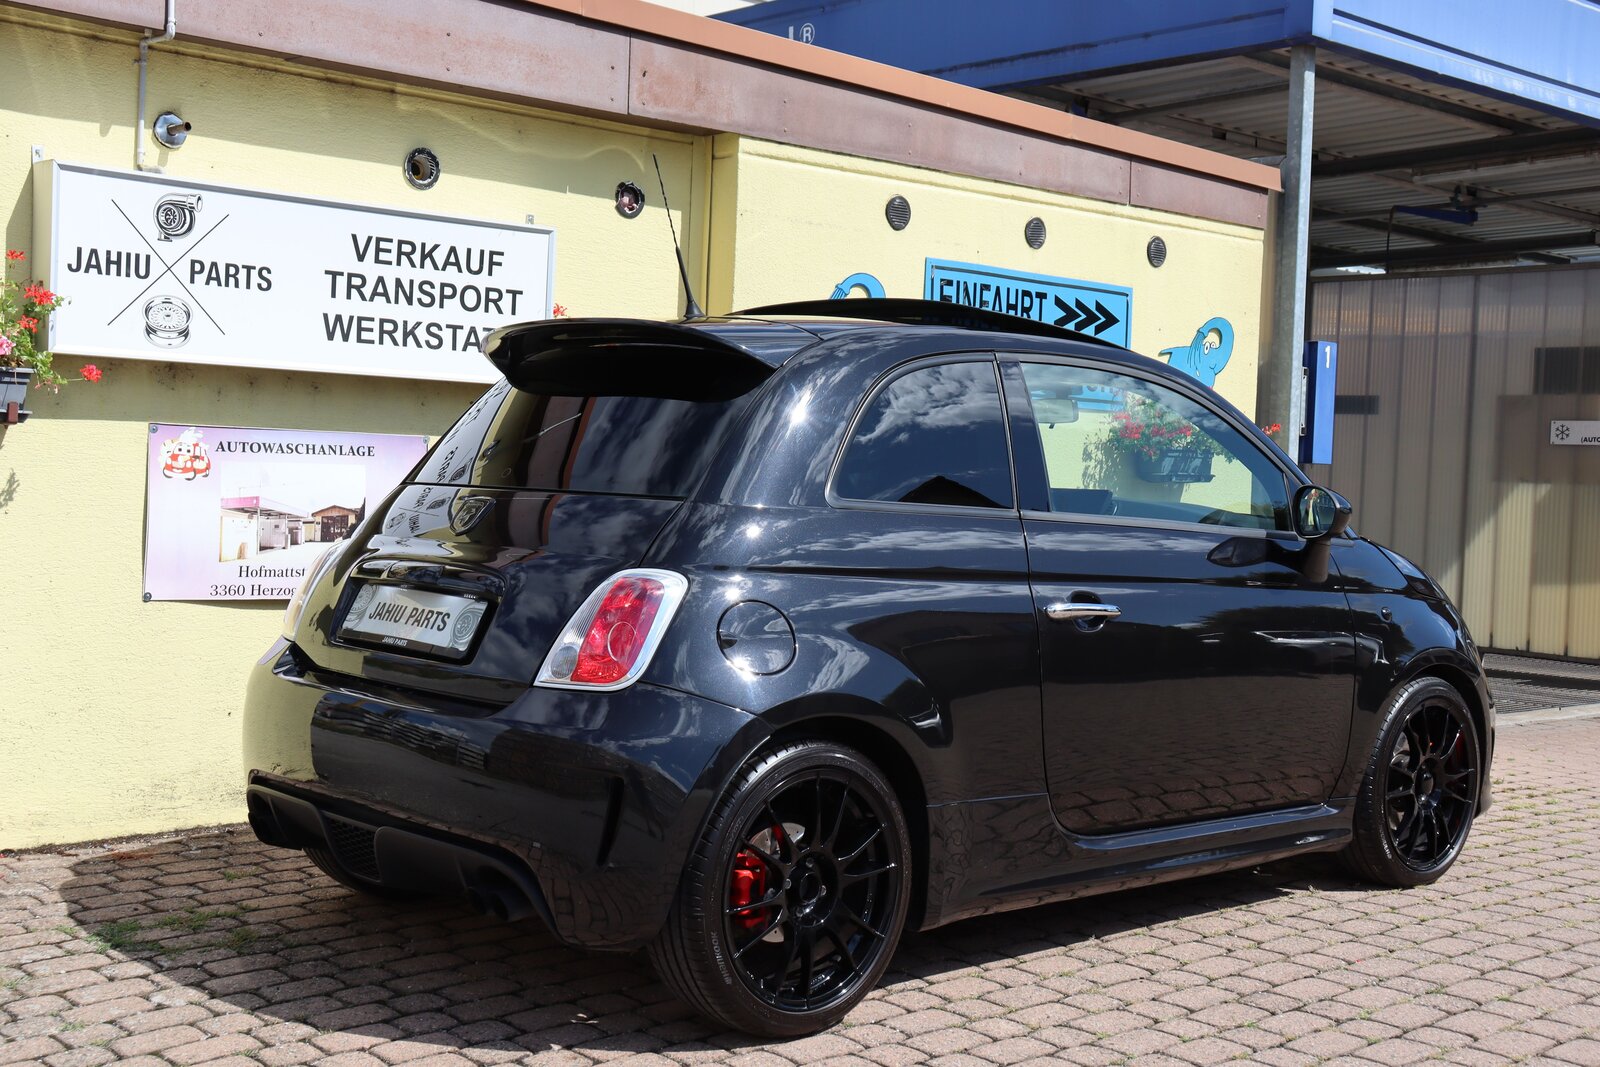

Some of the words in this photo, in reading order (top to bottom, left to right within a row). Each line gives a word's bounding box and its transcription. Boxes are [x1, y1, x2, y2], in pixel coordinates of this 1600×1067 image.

[67, 247, 152, 281] JAHIU
[189, 259, 272, 292] PARTS
[350, 233, 505, 277] VERKAUF
[324, 270, 523, 316] TRANSPORT
[939, 278, 1048, 322] EINFAHRT
[1324, 345, 1331, 369] 1
[215, 441, 375, 457] AUTOWASCHANLAGE
[209, 584, 246, 597] 3360
[368, 602, 408, 624] JAHIU
[404, 607, 451, 632] PARTS
